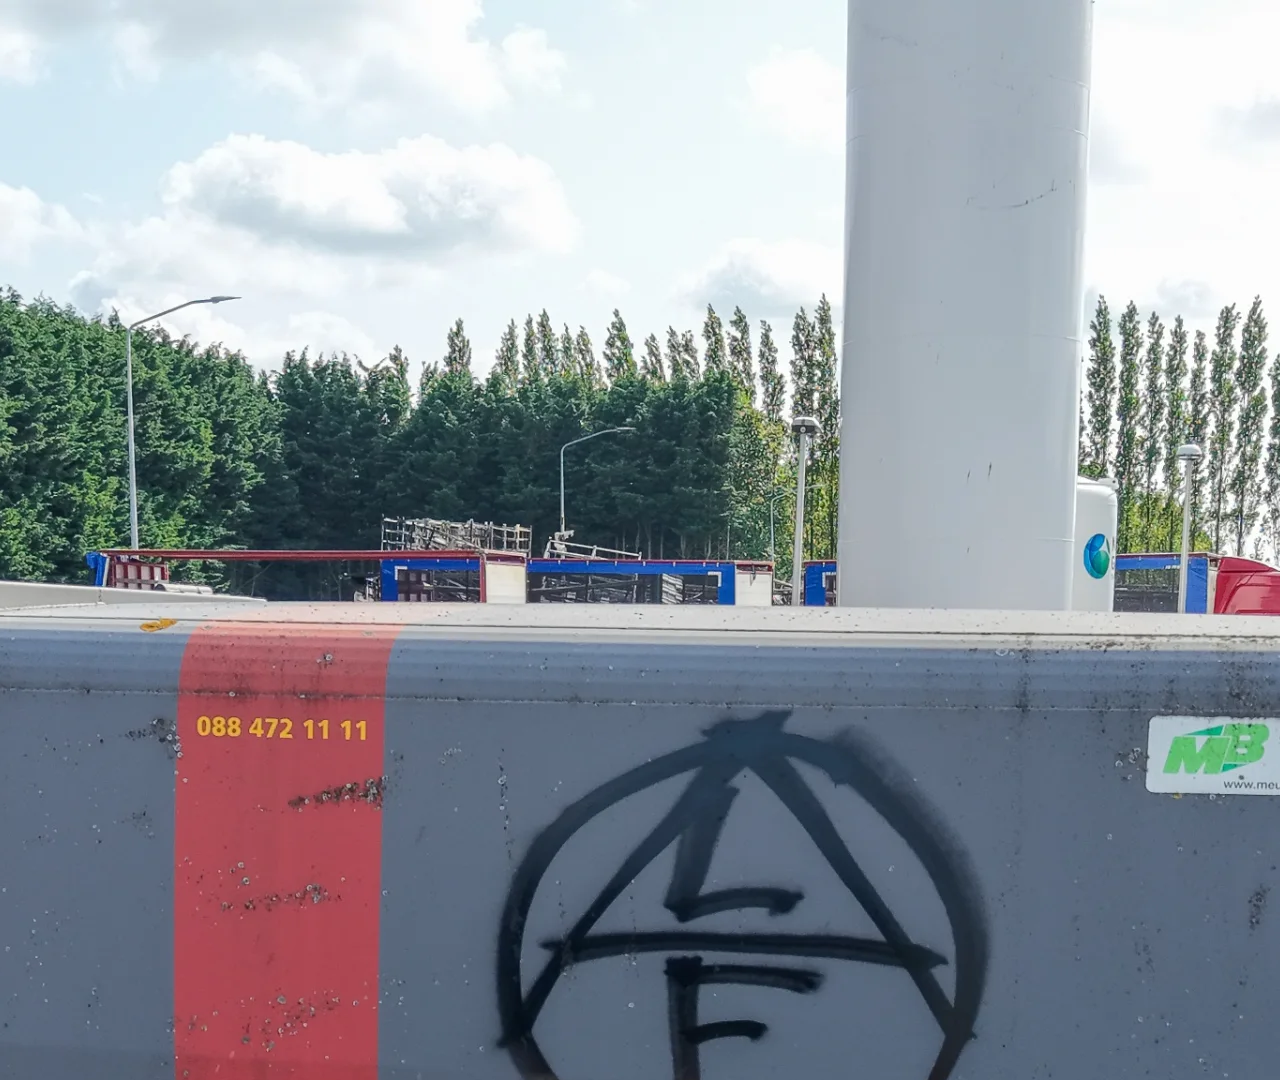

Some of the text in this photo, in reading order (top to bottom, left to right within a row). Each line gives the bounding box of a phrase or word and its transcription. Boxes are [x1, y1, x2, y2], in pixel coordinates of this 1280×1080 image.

[196, 715, 367, 741] 088 472 11 11
[1162, 723, 1270, 775] MB
